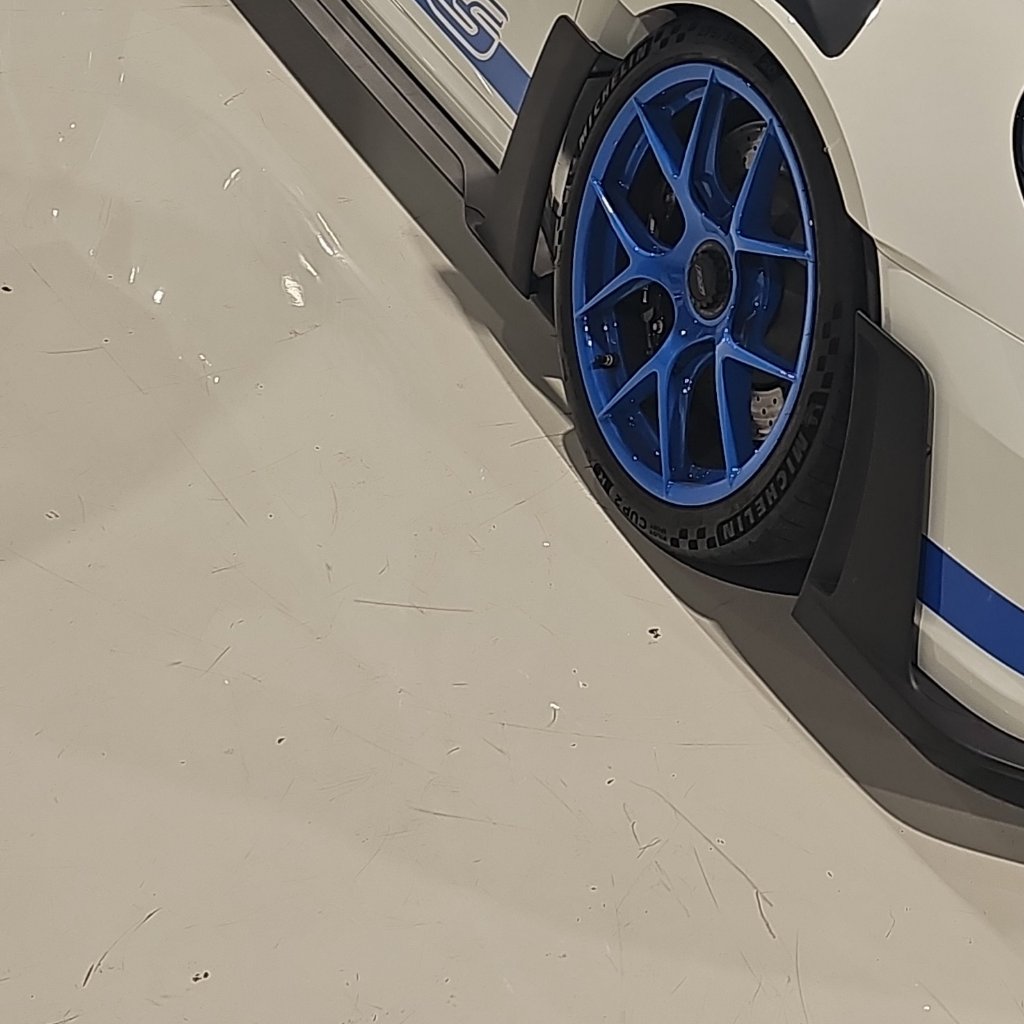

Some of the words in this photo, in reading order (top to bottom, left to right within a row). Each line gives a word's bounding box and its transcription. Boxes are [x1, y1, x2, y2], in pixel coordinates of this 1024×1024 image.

[578, 44, 648, 151] MICHELIN
[612, 494, 624, 508] 2
[620, 503, 648, 531] CUP
[722, 431, 809, 541] MICHELIN
